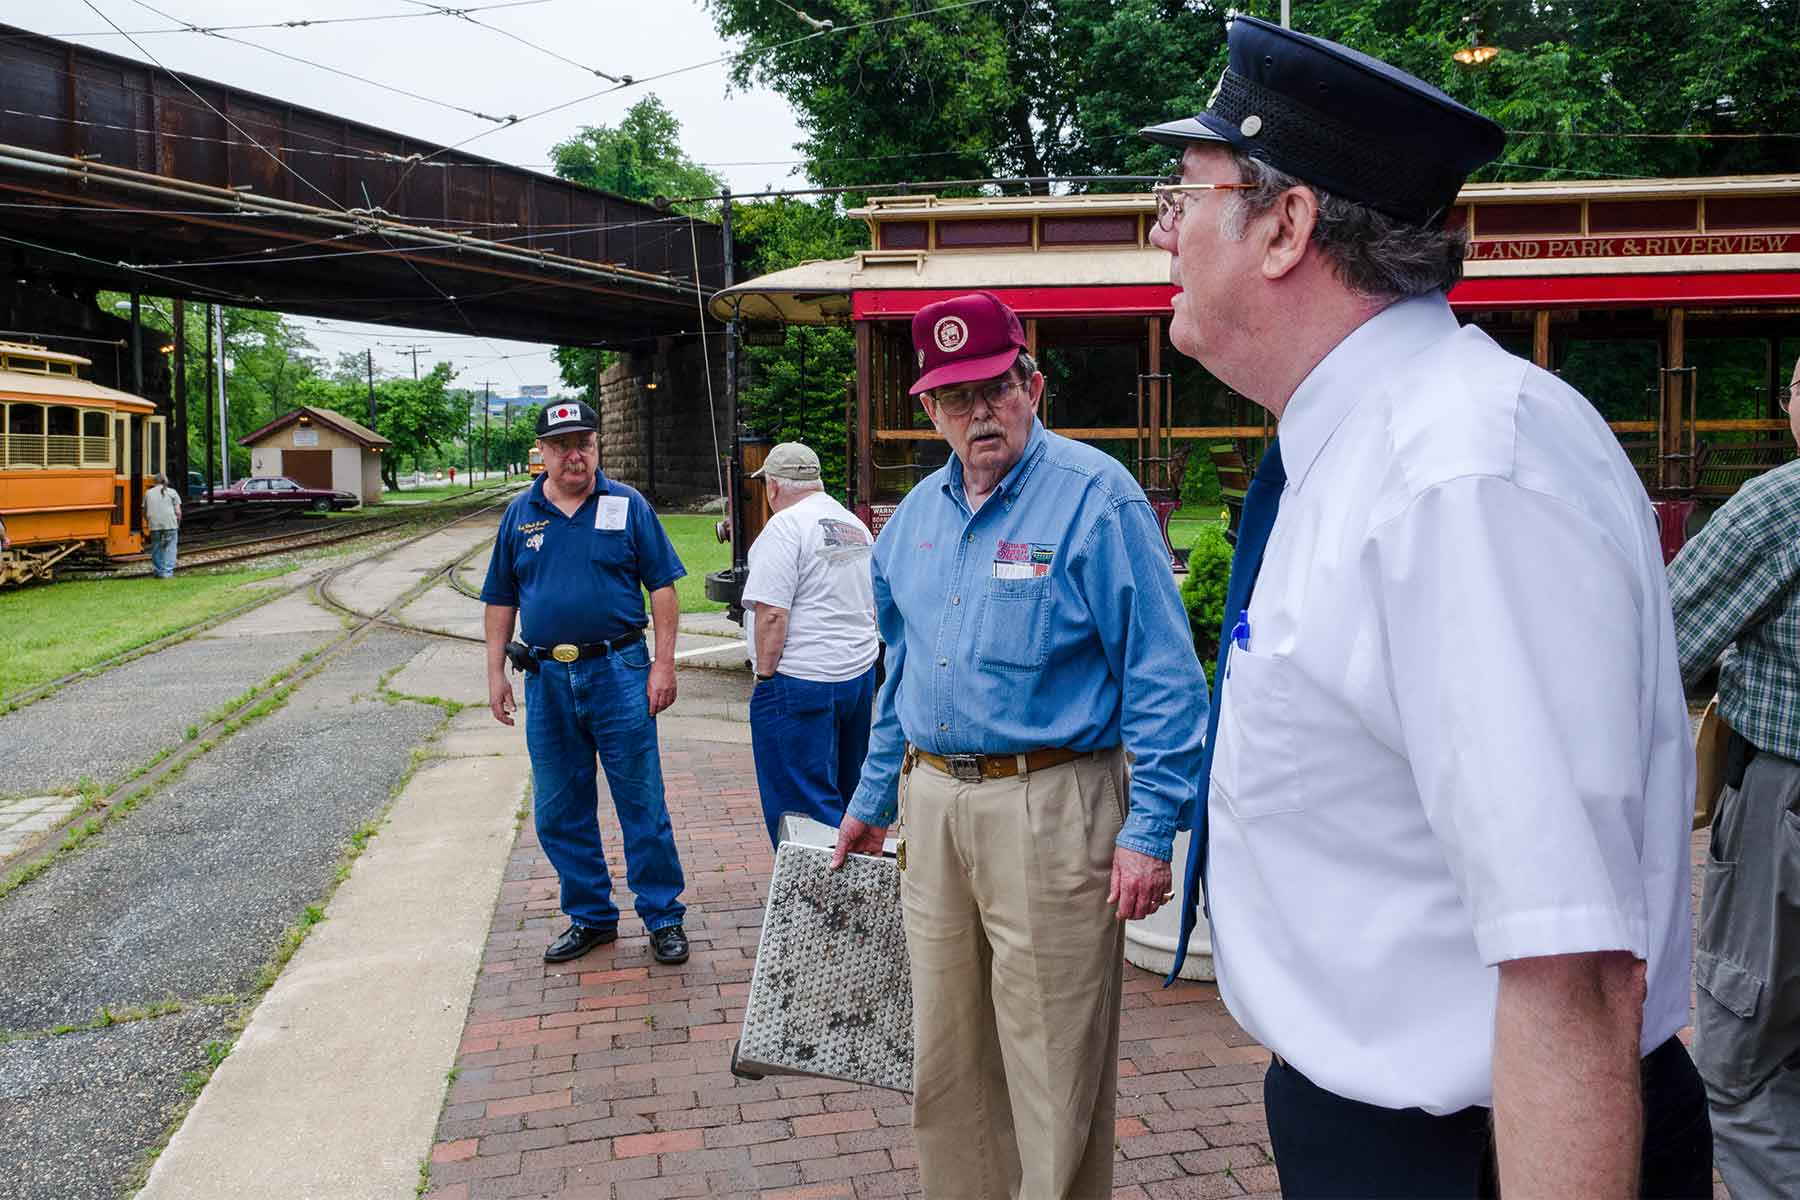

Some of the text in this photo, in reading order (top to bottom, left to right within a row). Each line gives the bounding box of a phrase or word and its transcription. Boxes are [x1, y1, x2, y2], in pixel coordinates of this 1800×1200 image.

[1548, 239, 1616, 257] PARK
[1622, 238, 1641, 256] &
[1645, 235, 1791, 255] RIVERVIEW
